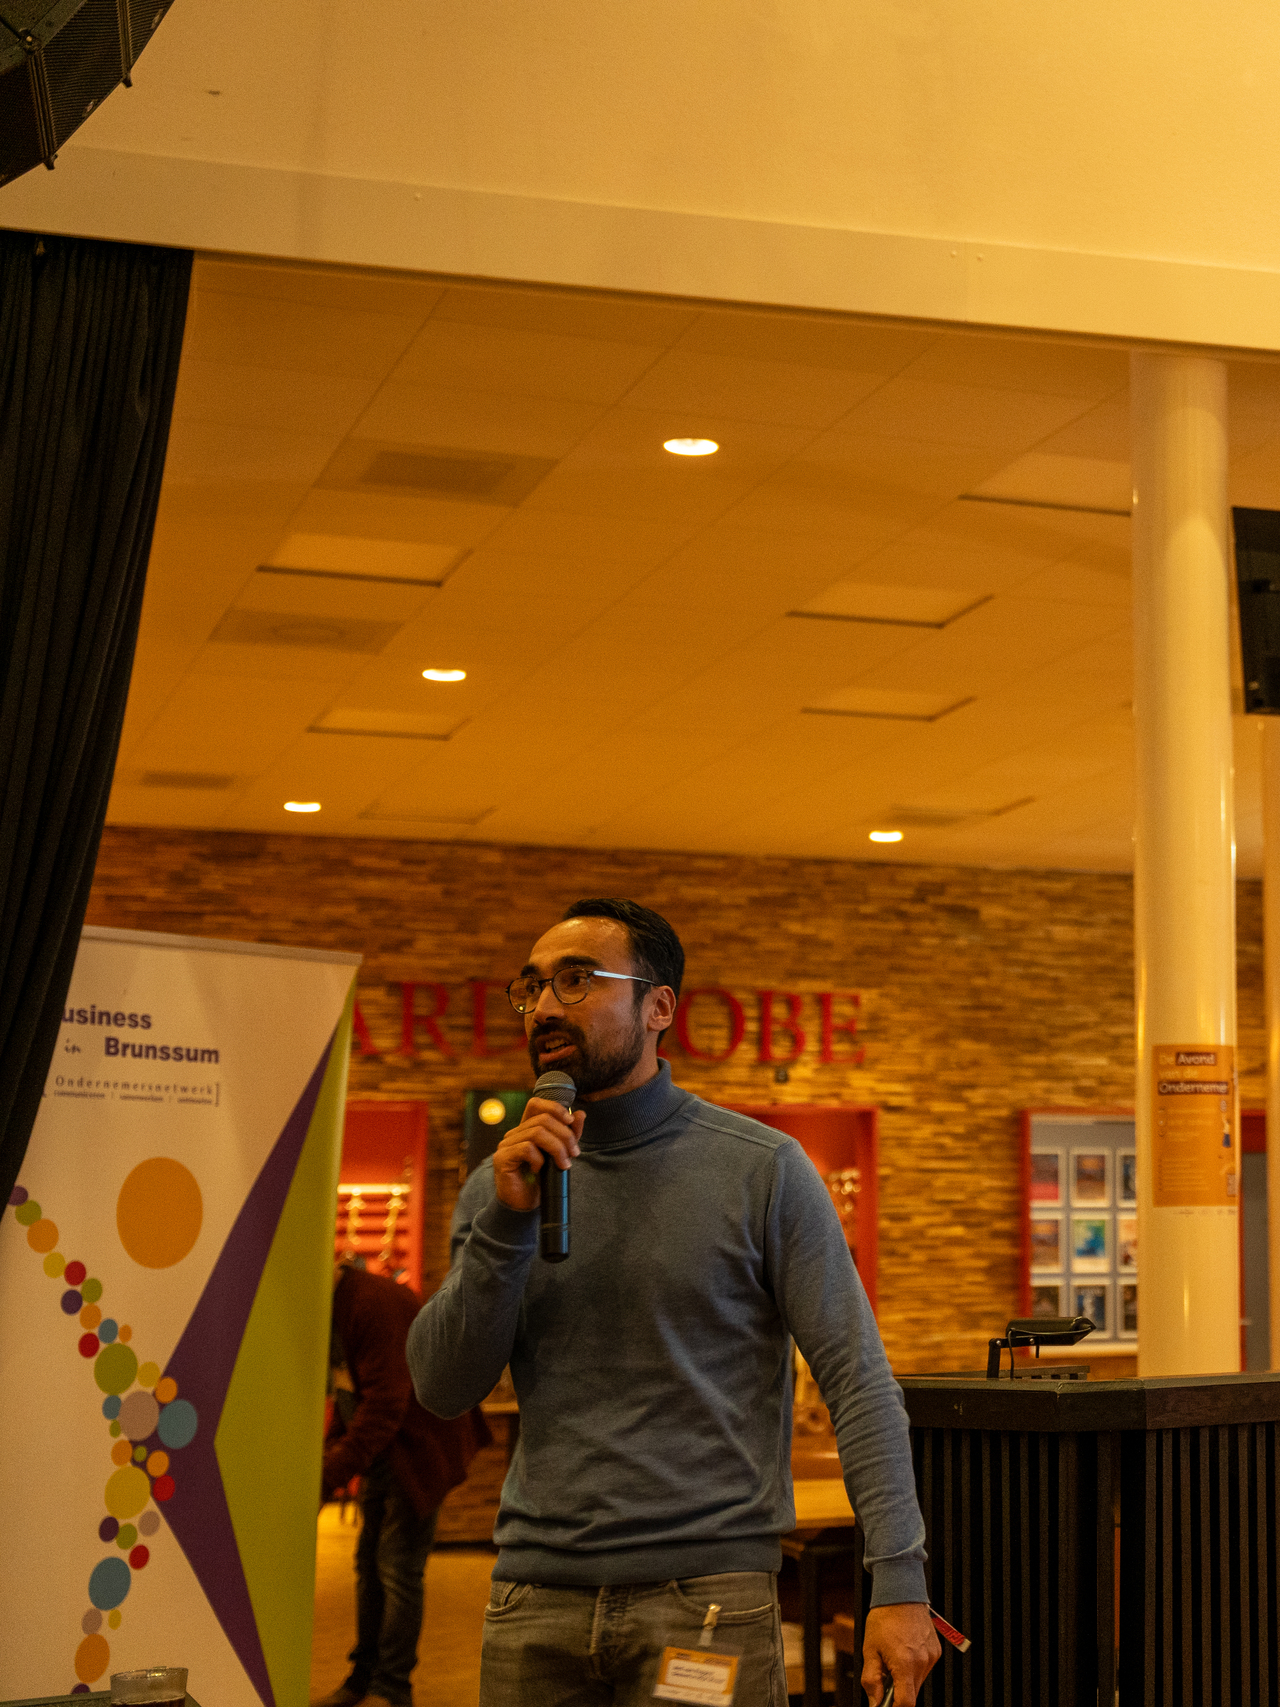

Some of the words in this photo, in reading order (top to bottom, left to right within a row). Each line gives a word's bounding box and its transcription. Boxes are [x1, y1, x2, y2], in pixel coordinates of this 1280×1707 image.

[62, 1004, 152, 1029] usiness
[354, 980, 866, 1065] RDOBE
[104, 1036, 220, 1064] Brunssum
[1178, 1053, 1215, 1065] Avond
[1160, 1082, 1227, 1094] Onderneme
